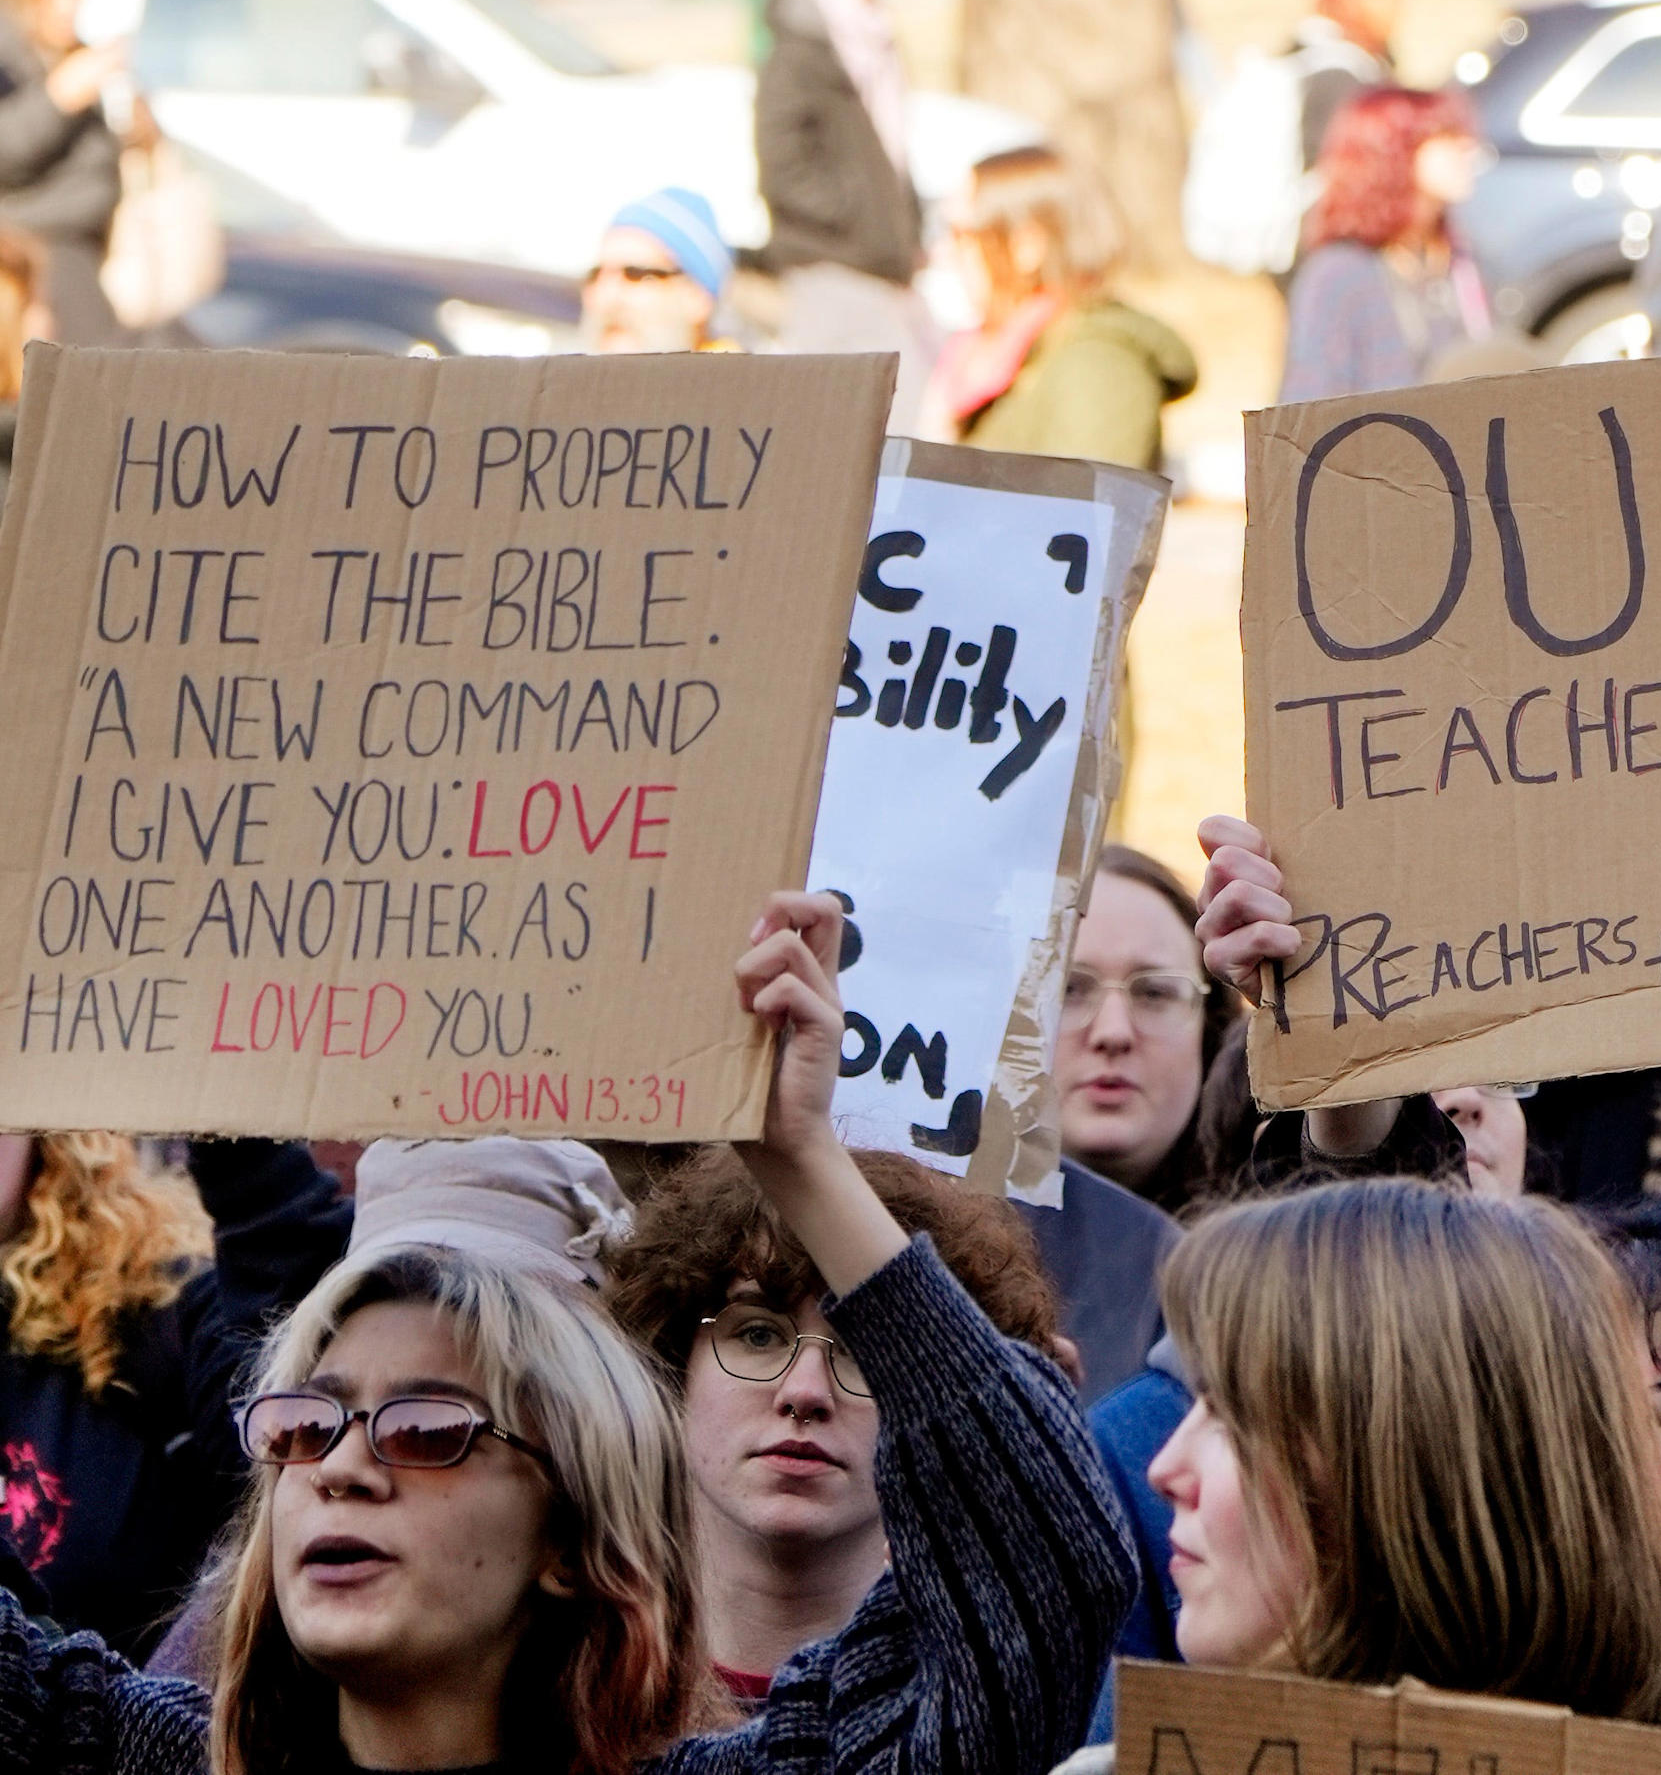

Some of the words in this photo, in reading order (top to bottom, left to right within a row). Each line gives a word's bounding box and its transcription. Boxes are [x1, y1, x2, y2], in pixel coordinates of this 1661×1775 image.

[114, 417, 301, 514] HOW
[329, 424, 437, 509] TO
[472, 426, 774, 513] PROPERLY
[1295, 406, 1646, 661] OU
[96, 544, 265, 646] CITE
[311, 550, 464, 647] THE
[481, 547, 730, 652] BIBLE:
[78, 667, 136, 763] "A
[173, 676, 323, 763] NEW
[357, 677, 720, 759] COMMAND
[64, 776, 83, 858] I
[110, 779, 276, 866] GIVE
[312, 778, 464, 864] YOU:
[467, 779, 679, 860] LOVE
[37, 876, 176, 959] ONE
[183, 880, 497, 961] ANOTHER.
[509, 884, 592, 961] AS
[641, 887, 656, 963] I
[19, 972, 188, 1055] HAVE
[210, 981, 407, 1060] LOVED
[1274, 912, 1638, 1035] PREACHERS
[585, 1075, 685, 1128] 13:34
